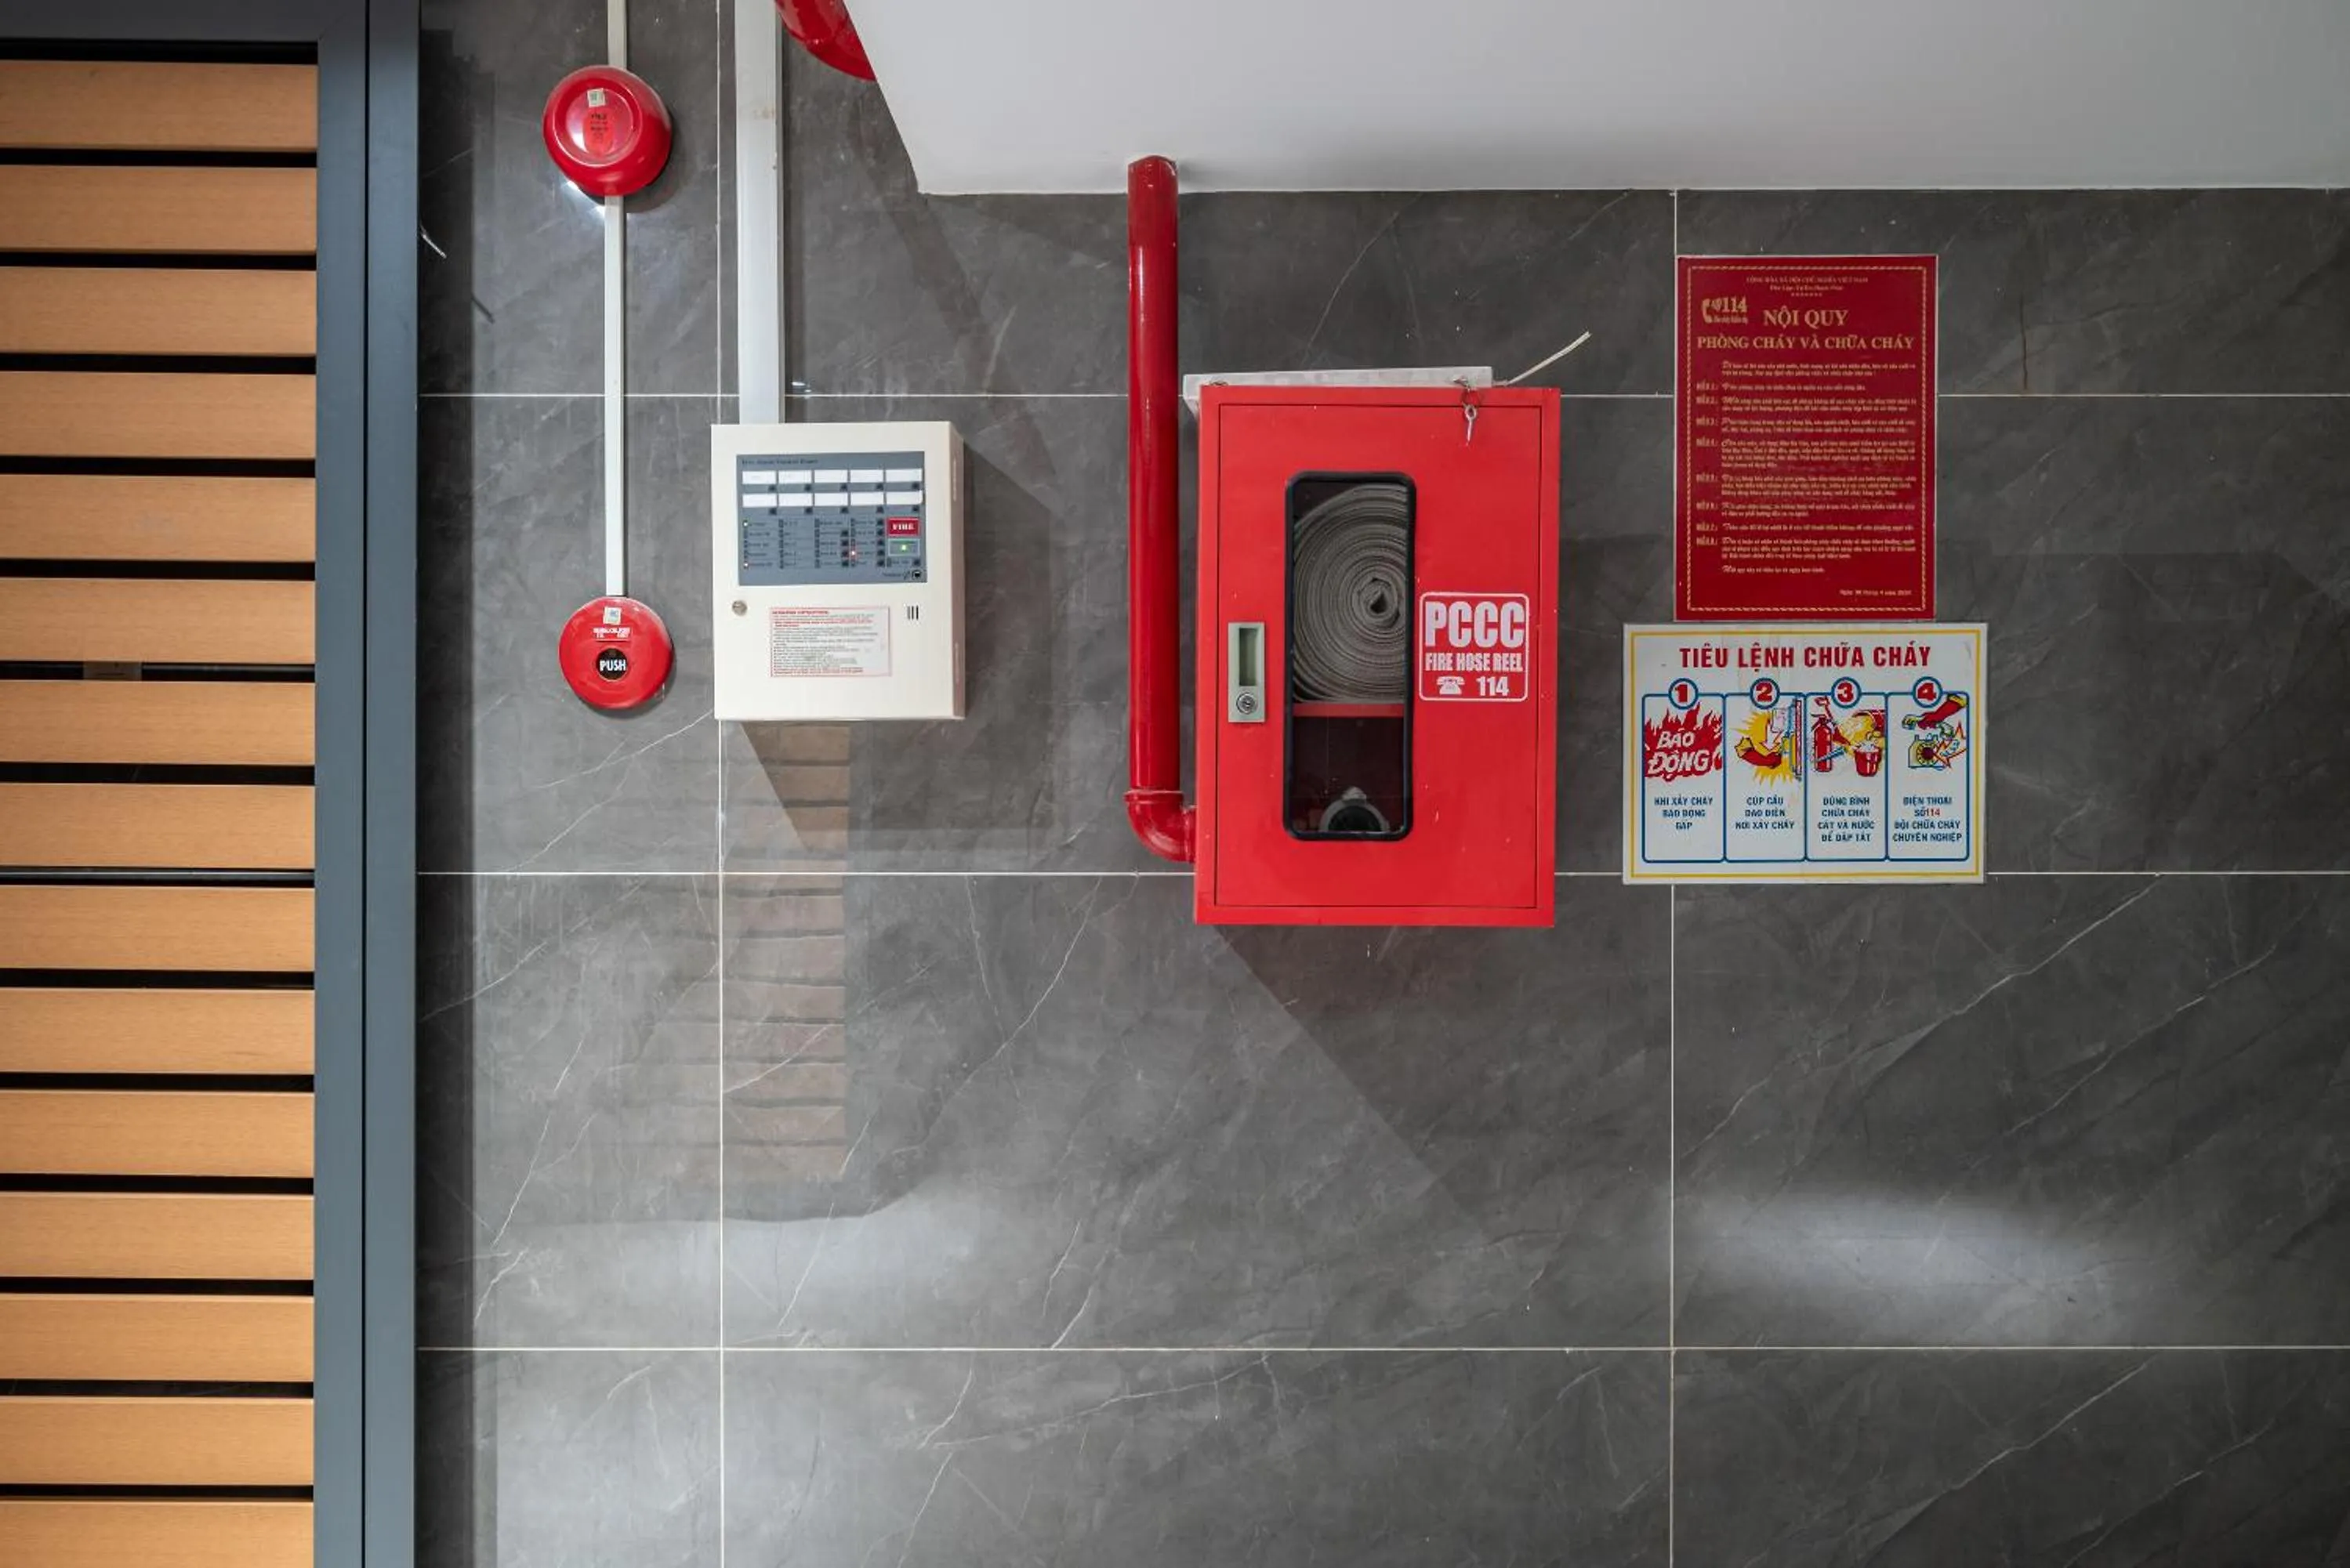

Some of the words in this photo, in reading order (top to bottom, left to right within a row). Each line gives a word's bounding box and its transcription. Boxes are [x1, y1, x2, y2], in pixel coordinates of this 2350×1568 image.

[1722, 296, 1748, 313] 114
[1764, 305, 1799, 328] NỘI
[1804, 310, 1848, 328] QUY
[1697, 334, 1749, 349] PHÒNG
[1753, 333, 1795, 349] CHÁY
[1800, 333, 1820, 349] VÀ
[1824, 333, 1866, 349] CHỮA
[1871, 333, 1914, 349] CHÁY
[1425, 601, 1525, 647] PCCC
[600, 660, 626, 672] PUSH
[1425, 653, 1452, 671] FIRE
[1456, 653, 1490, 672] HOSE
[1493, 653, 1523, 672] REEL
[1679, 643, 1728, 668] TIÊU
[1738, 643, 1794, 672] LỆNH
[1804, 642, 1865, 668] CHỮA
[1873, 640, 1931, 668] CHÁY
[1476, 676, 1510, 696] 114
[1675, 683, 1688, 703] 1
[1757, 682, 1773, 701] 2
[1837, 682, 1854, 702] 3
[1917, 682, 1937, 701] 4
[1648, 749, 1710, 779] ĐỘNG
